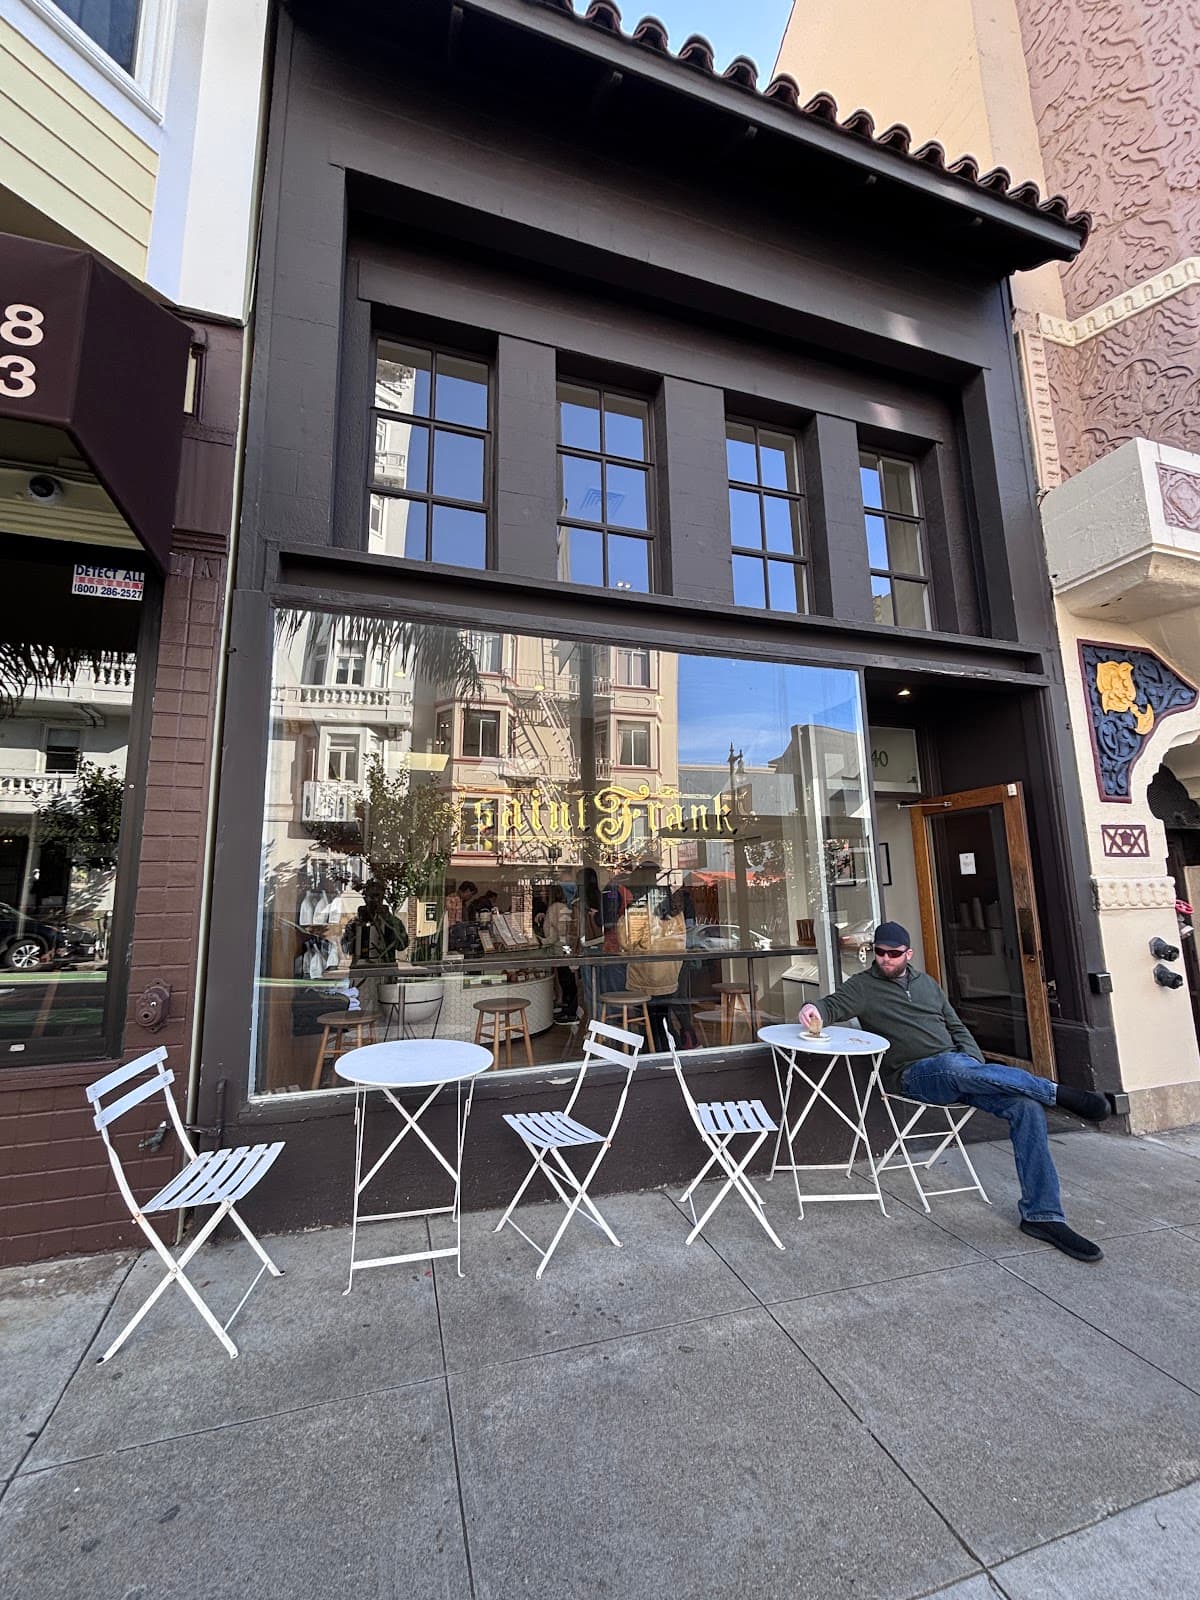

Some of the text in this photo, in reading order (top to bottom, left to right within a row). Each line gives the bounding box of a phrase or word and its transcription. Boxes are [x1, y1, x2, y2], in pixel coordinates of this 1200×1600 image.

[0, 304, 44, 346] 8
[0, 355, 36, 398] 3
[74, 583, 143, 598] (800) 286-2527
[76, 565, 144, 582] DETECT ALL
[593, 784, 734, 845] Frank
